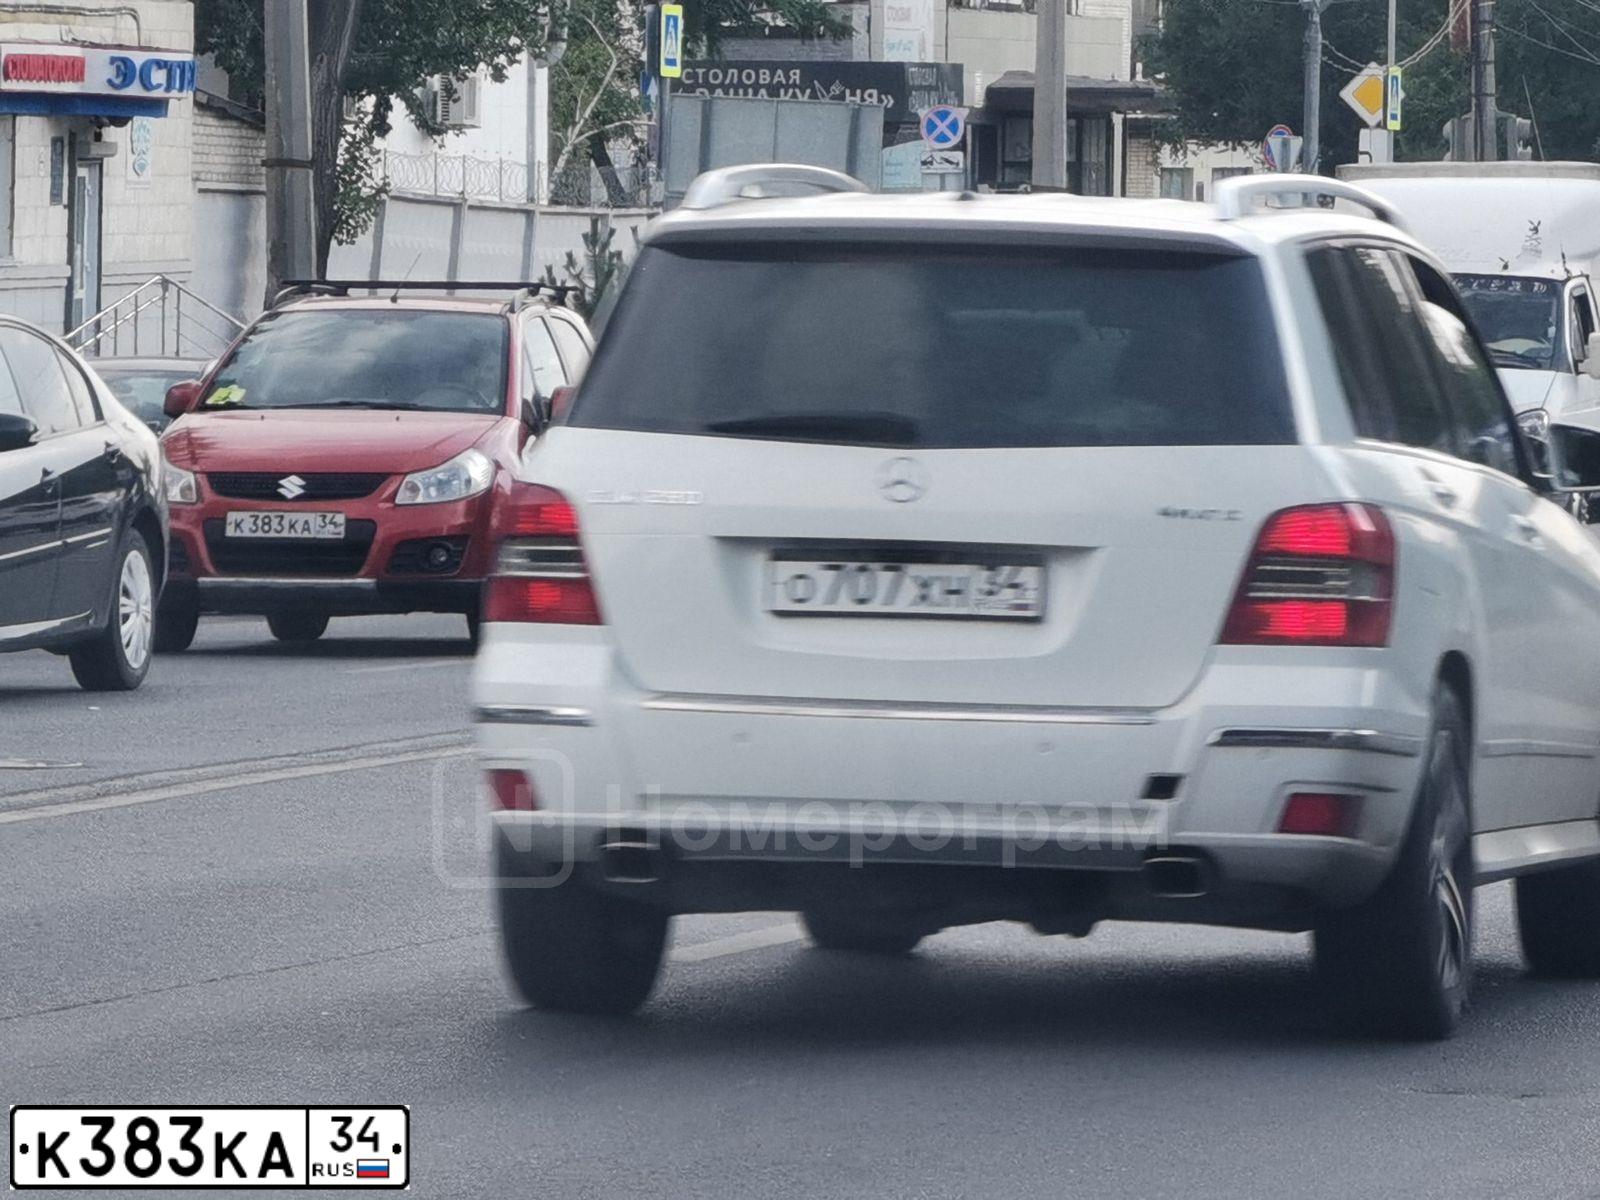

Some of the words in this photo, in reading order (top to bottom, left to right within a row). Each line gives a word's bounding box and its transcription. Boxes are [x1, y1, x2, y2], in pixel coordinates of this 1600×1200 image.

[681, 68, 801, 85] СТОЛОВАЯ
[234, 514, 312, 535] К383КА
[318, 513, 338, 529] 34
